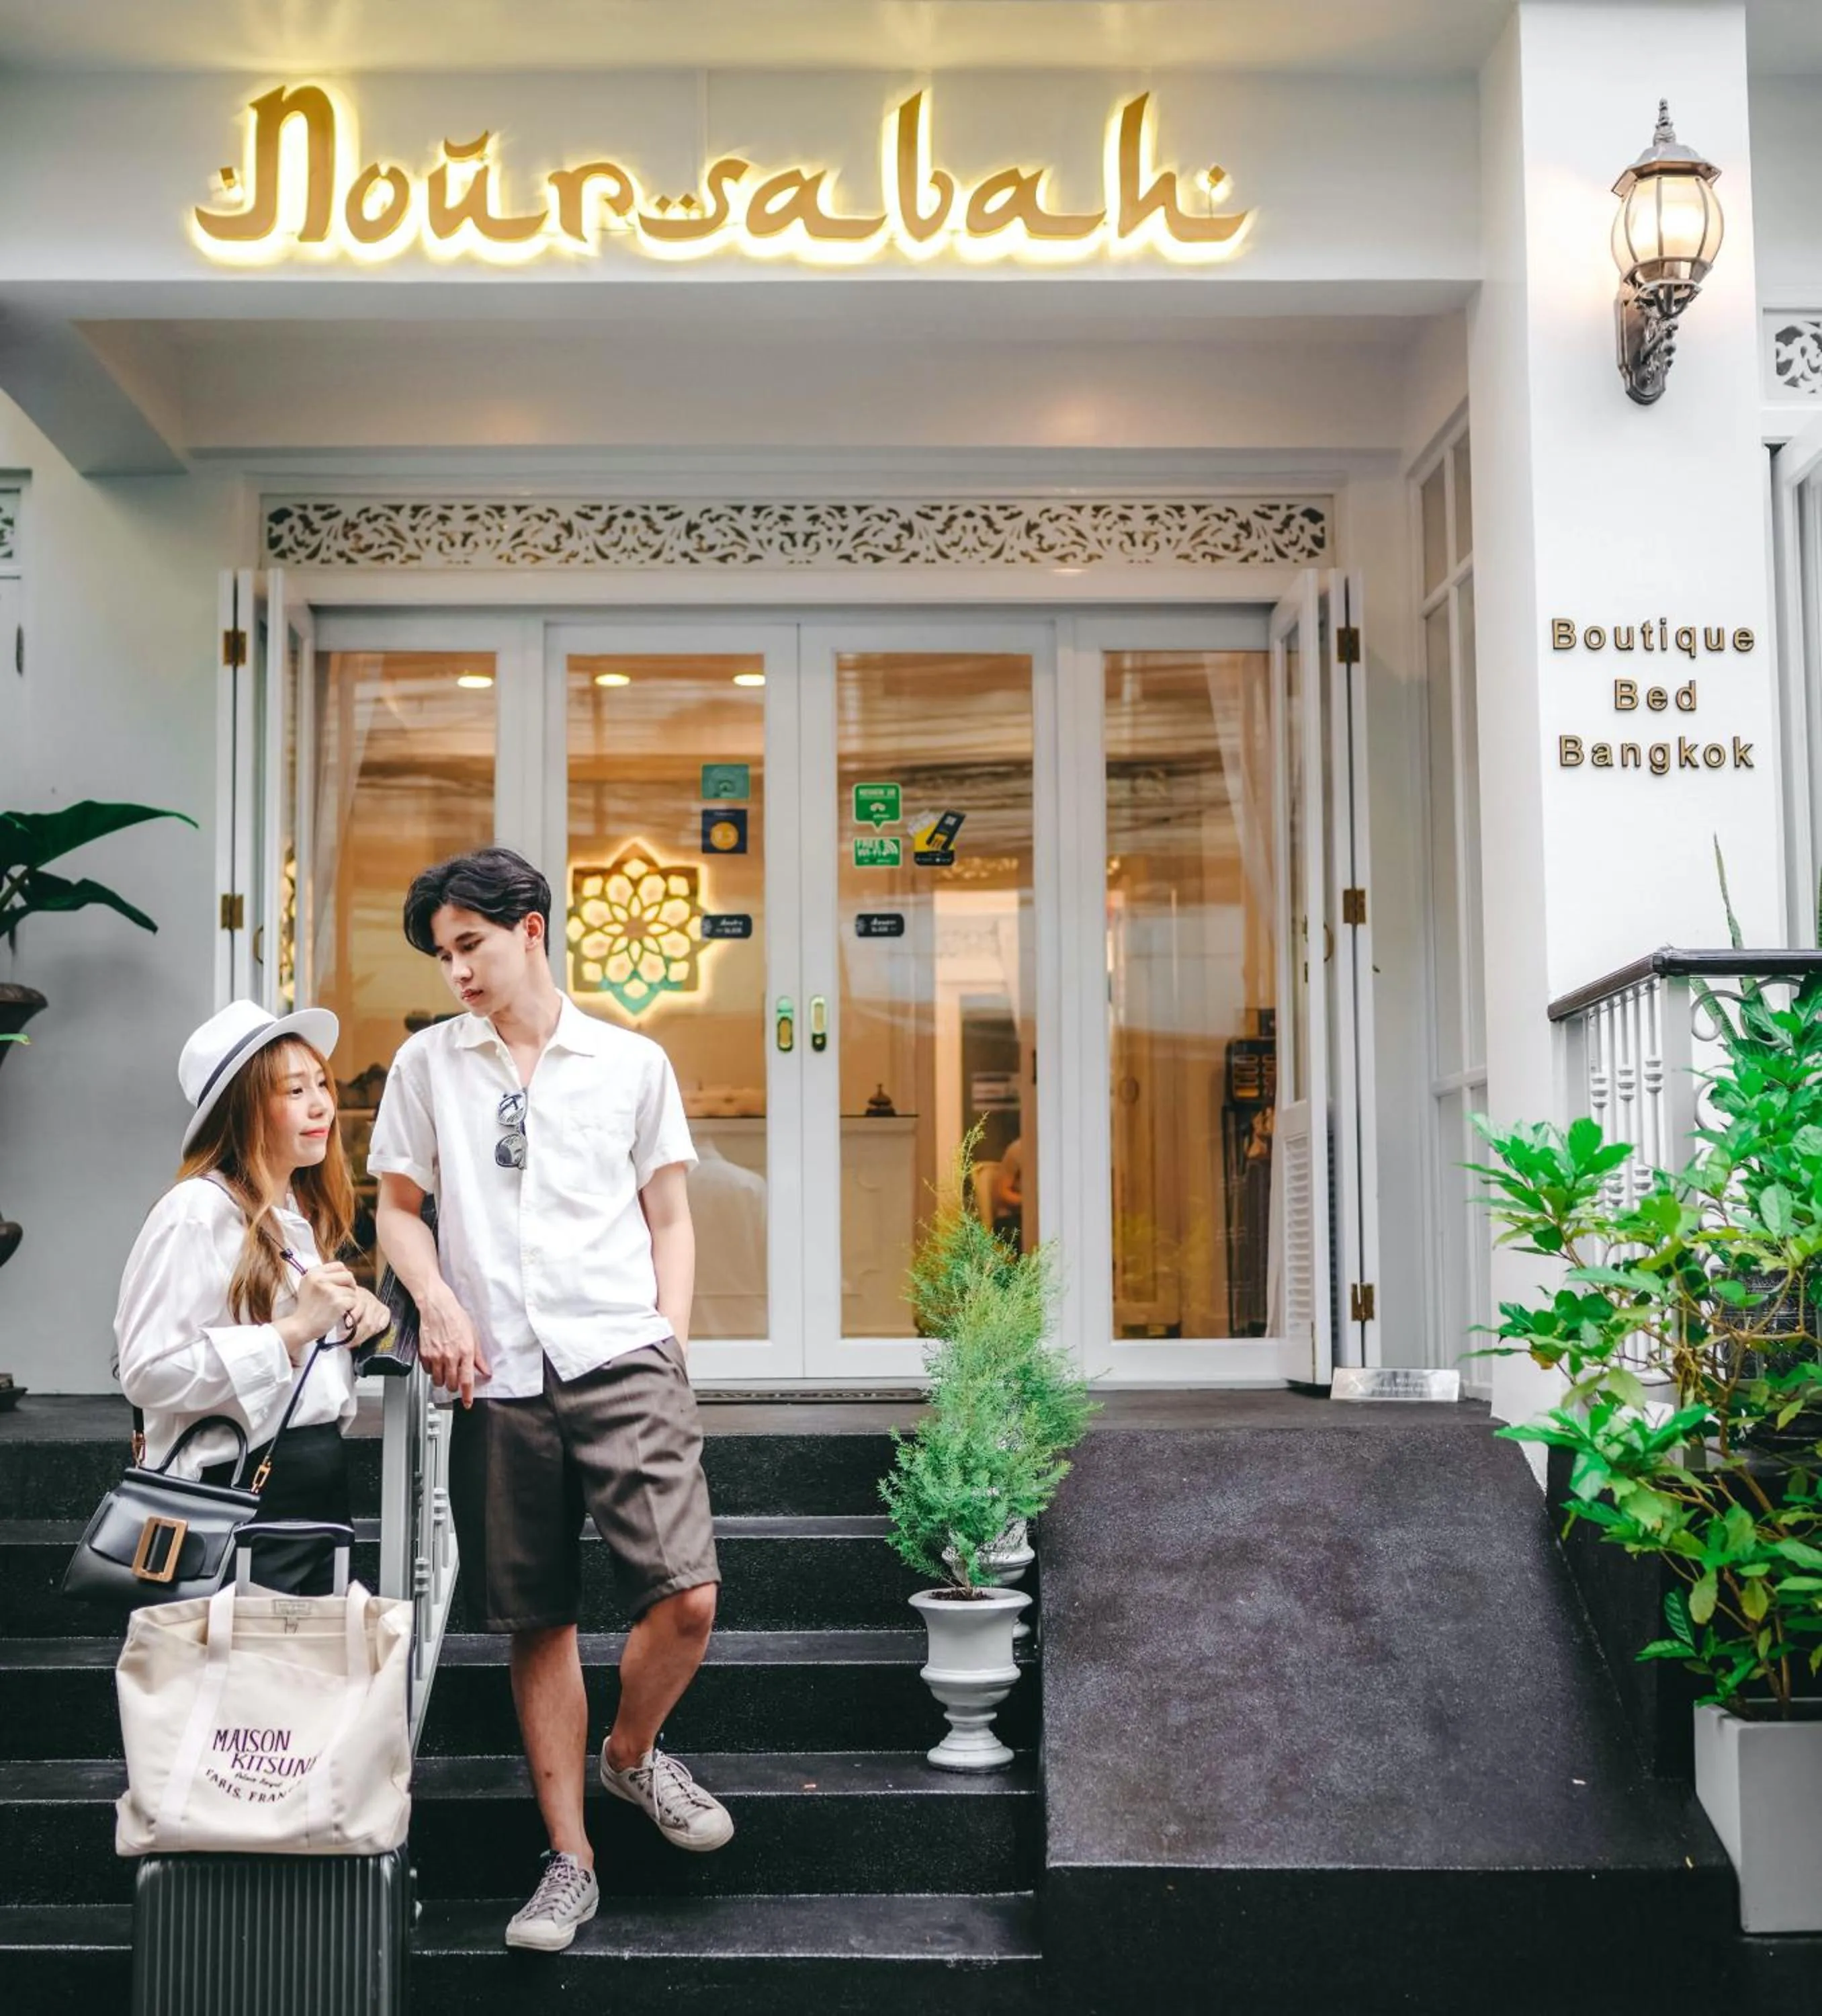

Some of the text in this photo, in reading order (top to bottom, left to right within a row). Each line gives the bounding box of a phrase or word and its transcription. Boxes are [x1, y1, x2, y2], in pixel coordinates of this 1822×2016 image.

[1551, 618, 1755, 659] Boutique
[1614, 679, 1697, 712] Bed
[1559, 734, 1754, 775] Bangkok
[212, 1728, 292, 1753] MAISON
